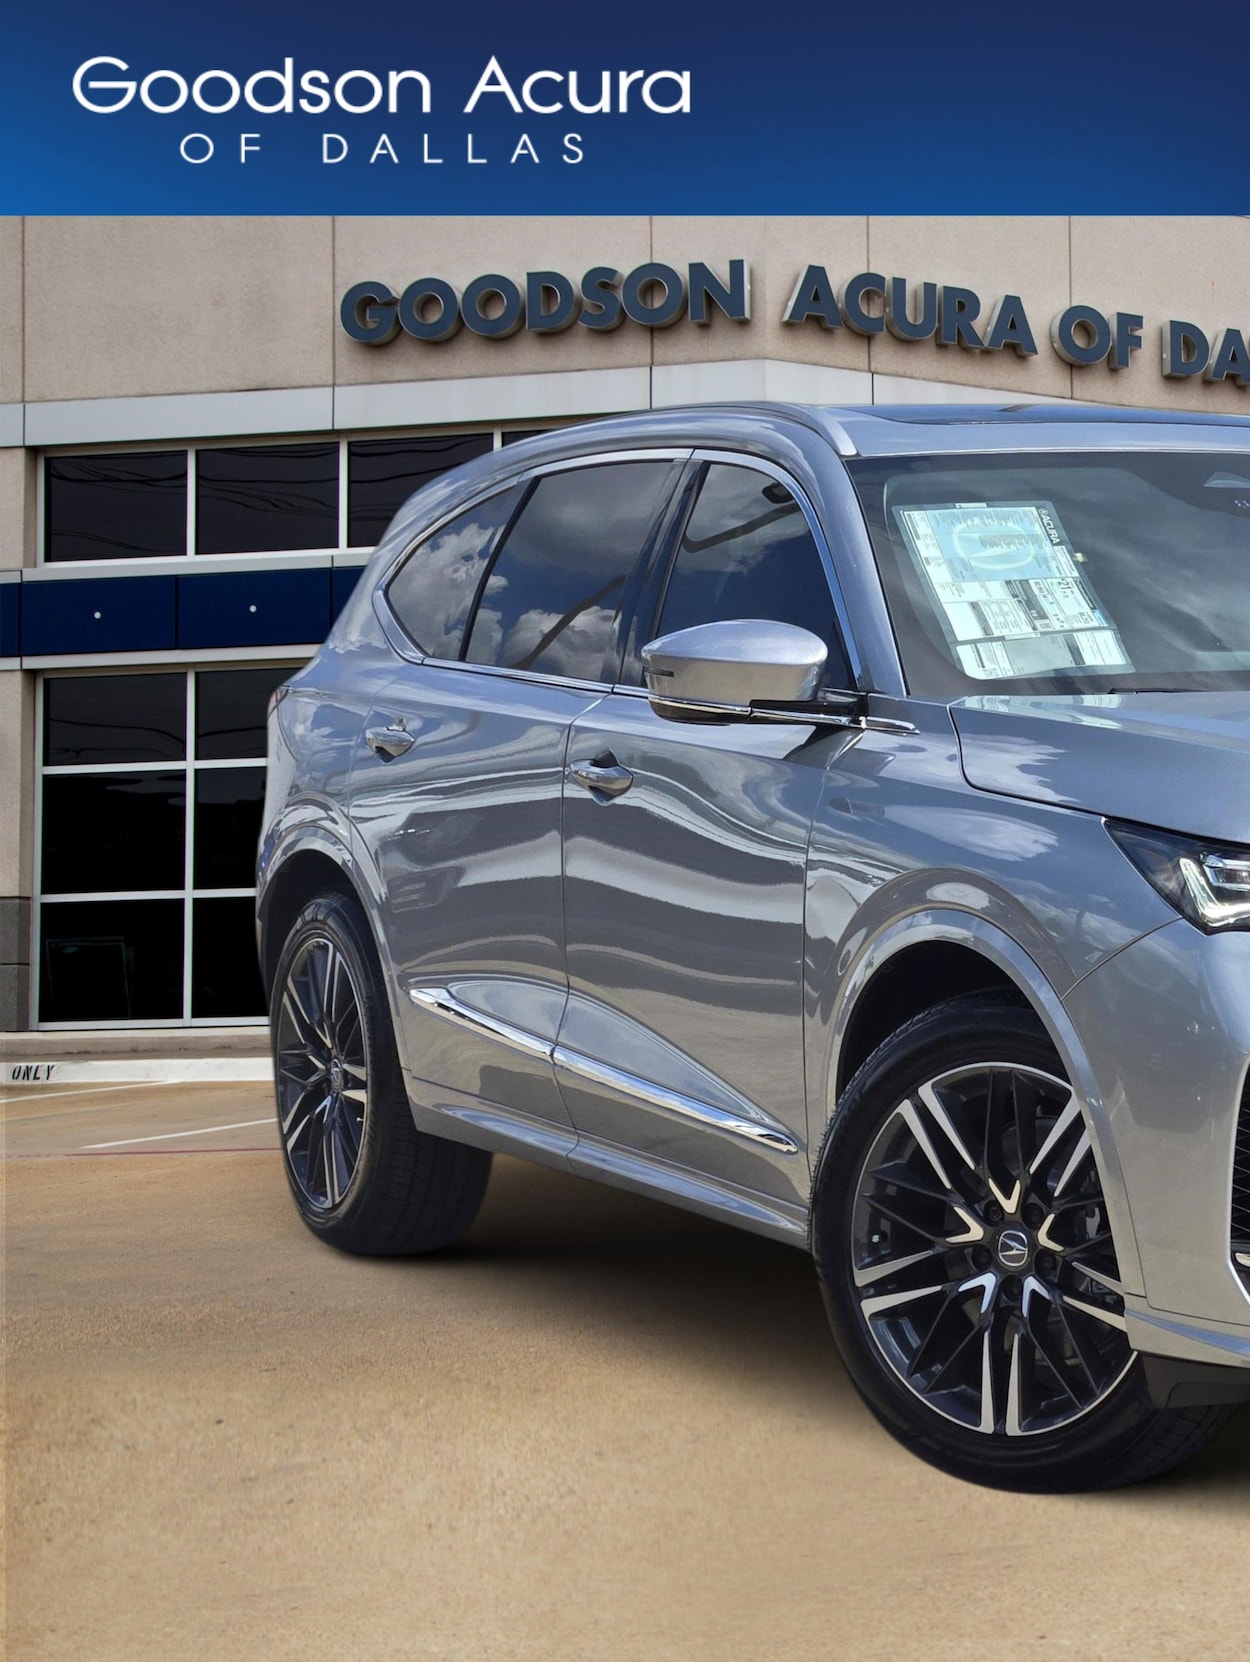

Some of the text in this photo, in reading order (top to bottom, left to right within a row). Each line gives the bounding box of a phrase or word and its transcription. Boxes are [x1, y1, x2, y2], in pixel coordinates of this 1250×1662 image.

[339, 259, 751, 346] GOODSON
[782, 264, 1040, 357] ACURA
[1051, 304, 1145, 370] OF
[1040, 514, 1061, 545] ACURA
[11, 1063, 55, 1081] ONLY
